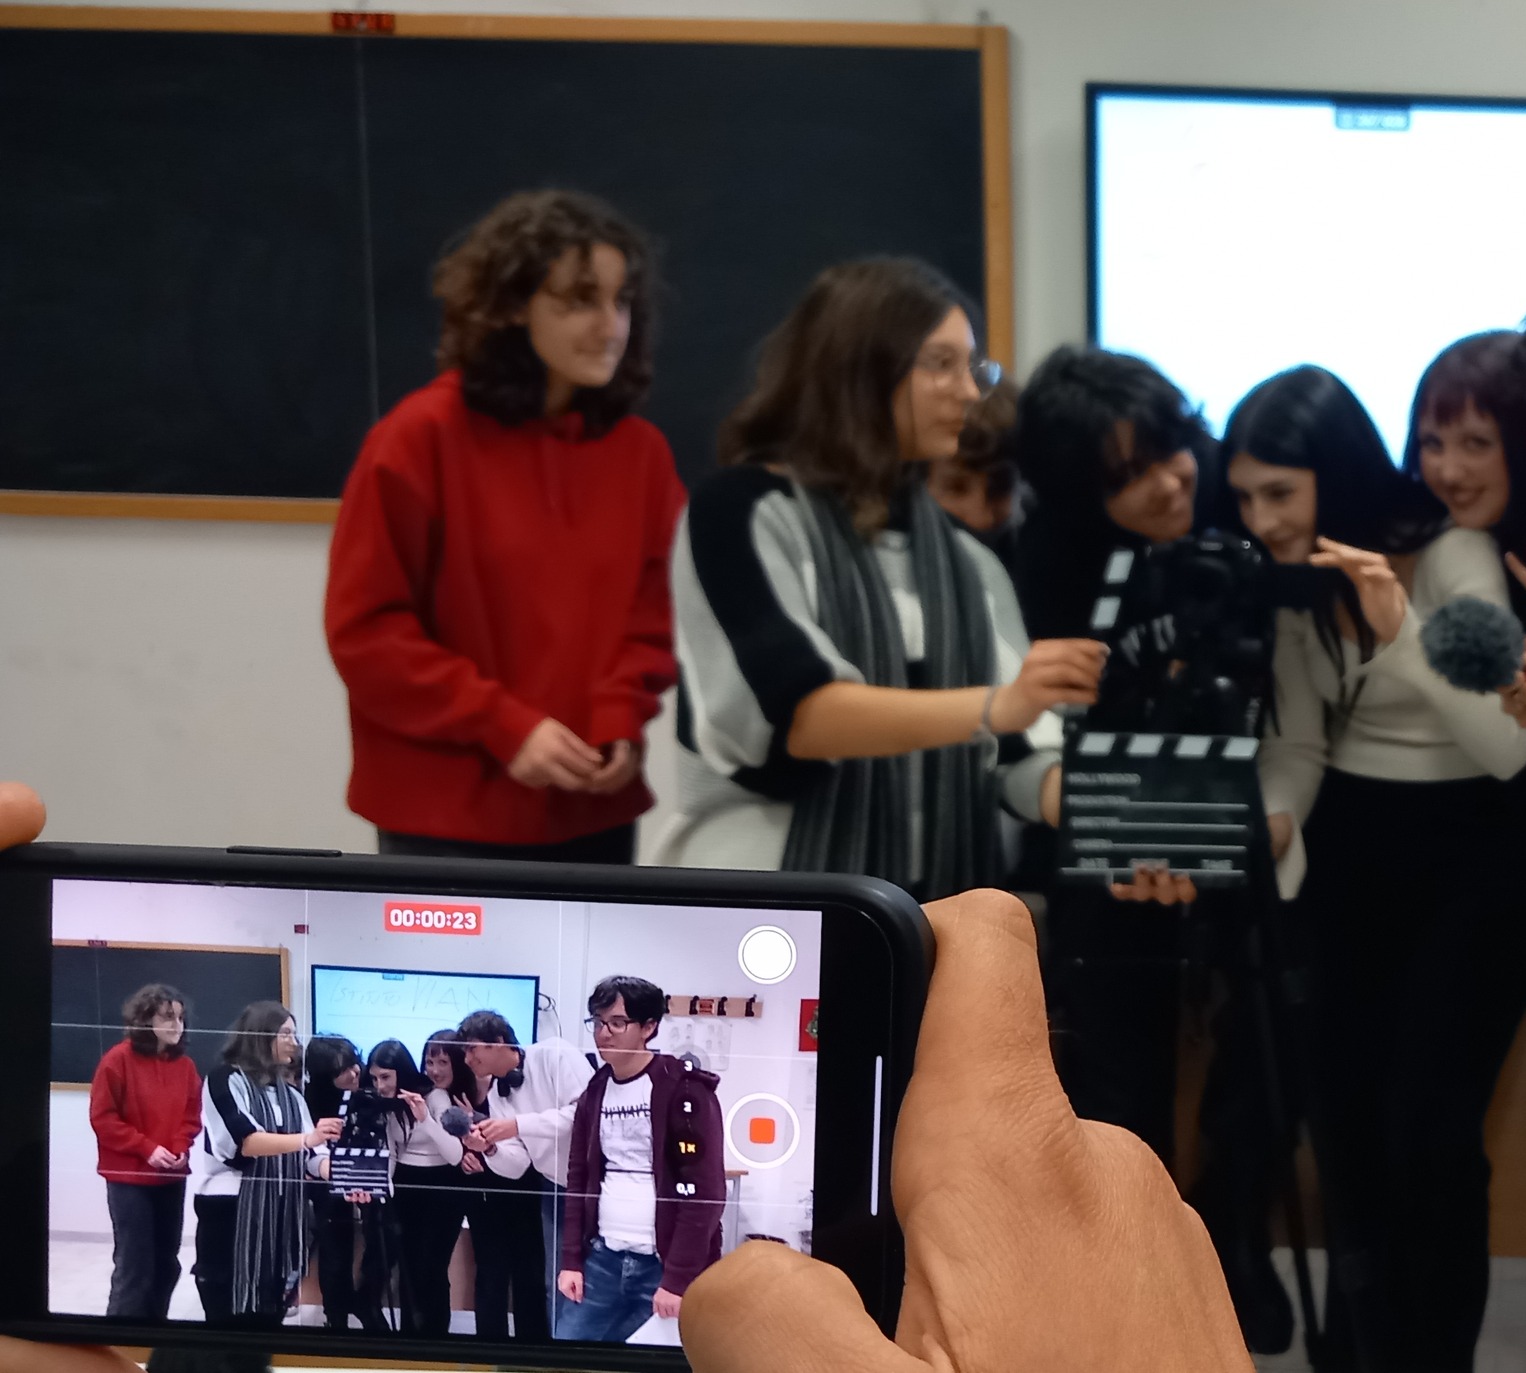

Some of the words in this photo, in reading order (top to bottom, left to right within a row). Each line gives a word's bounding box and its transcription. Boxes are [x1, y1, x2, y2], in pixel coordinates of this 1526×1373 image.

[390, 908, 477, 930] 00:00:23
[684, 1060, 693, 1071] 3
[683, 1101, 692, 1112] 2
